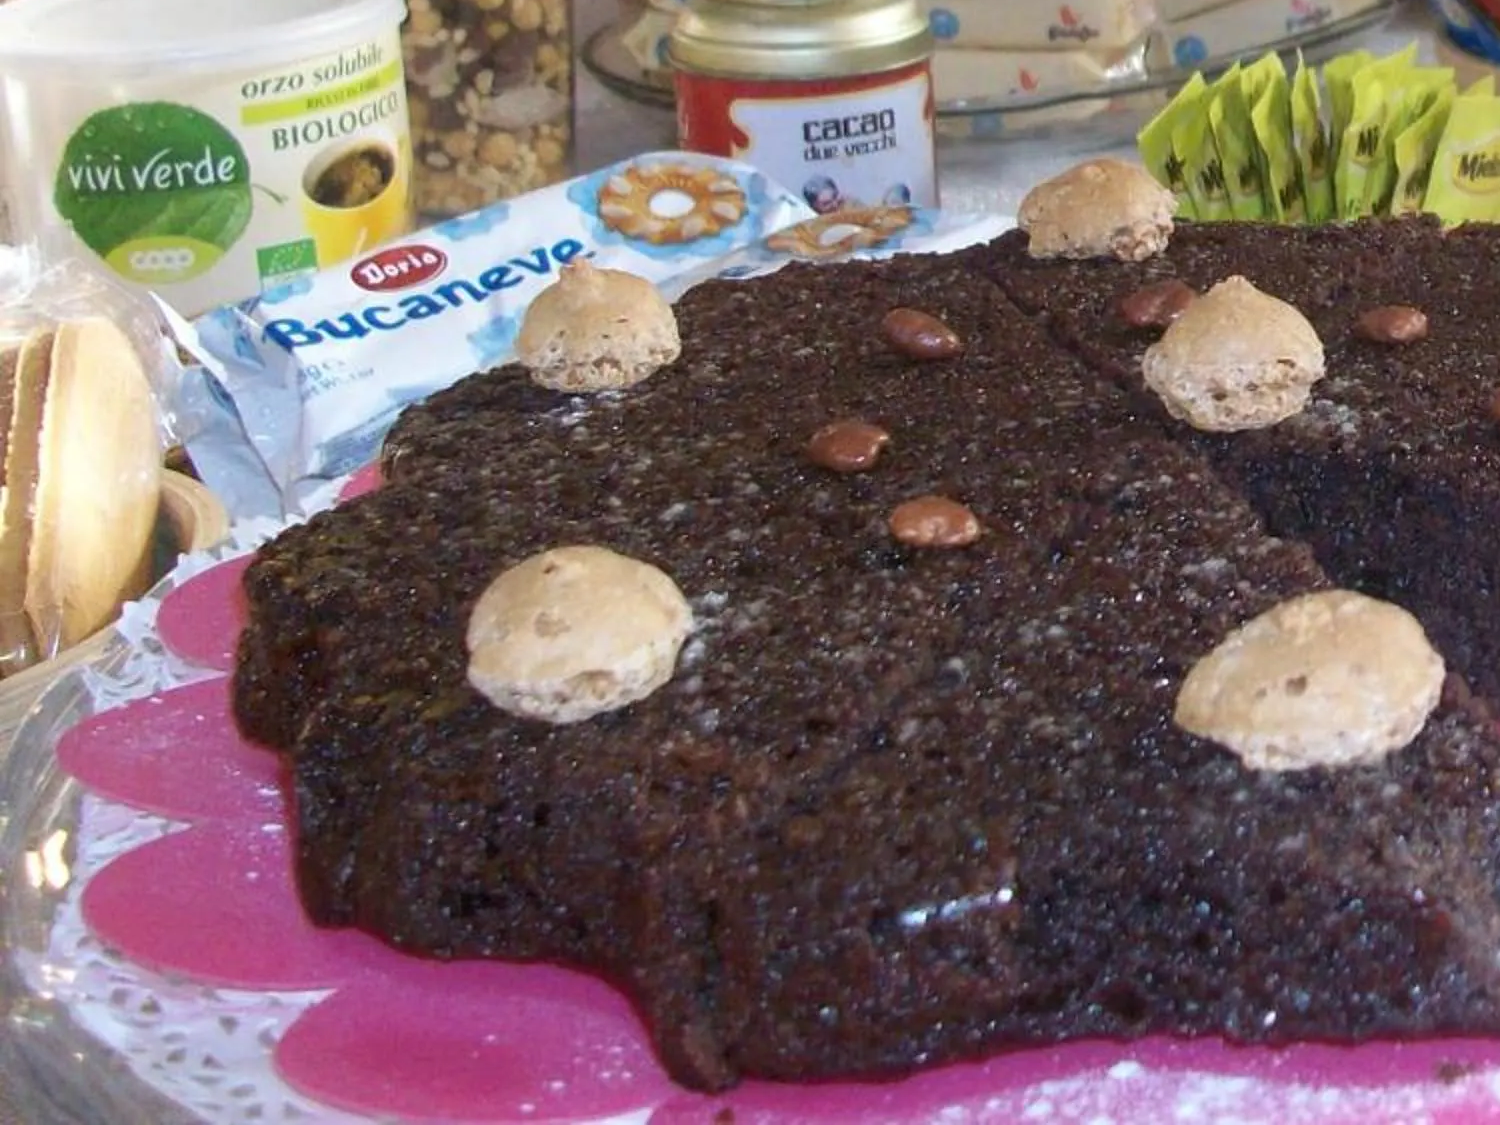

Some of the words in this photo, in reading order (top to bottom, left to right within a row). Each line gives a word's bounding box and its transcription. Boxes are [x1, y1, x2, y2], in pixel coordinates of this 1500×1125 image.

[241, 74, 304, 100] orzo
[271, 90, 399, 152] BIOLOGICO
[803, 108, 895, 143] cacao
[67, 153, 126, 192] vivi
[131, 144, 237, 192] verde
[803, 141, 838, 162] due
[360, 248, 439, 285] Doria
[262, 238, 595, 354] Bucaneve
